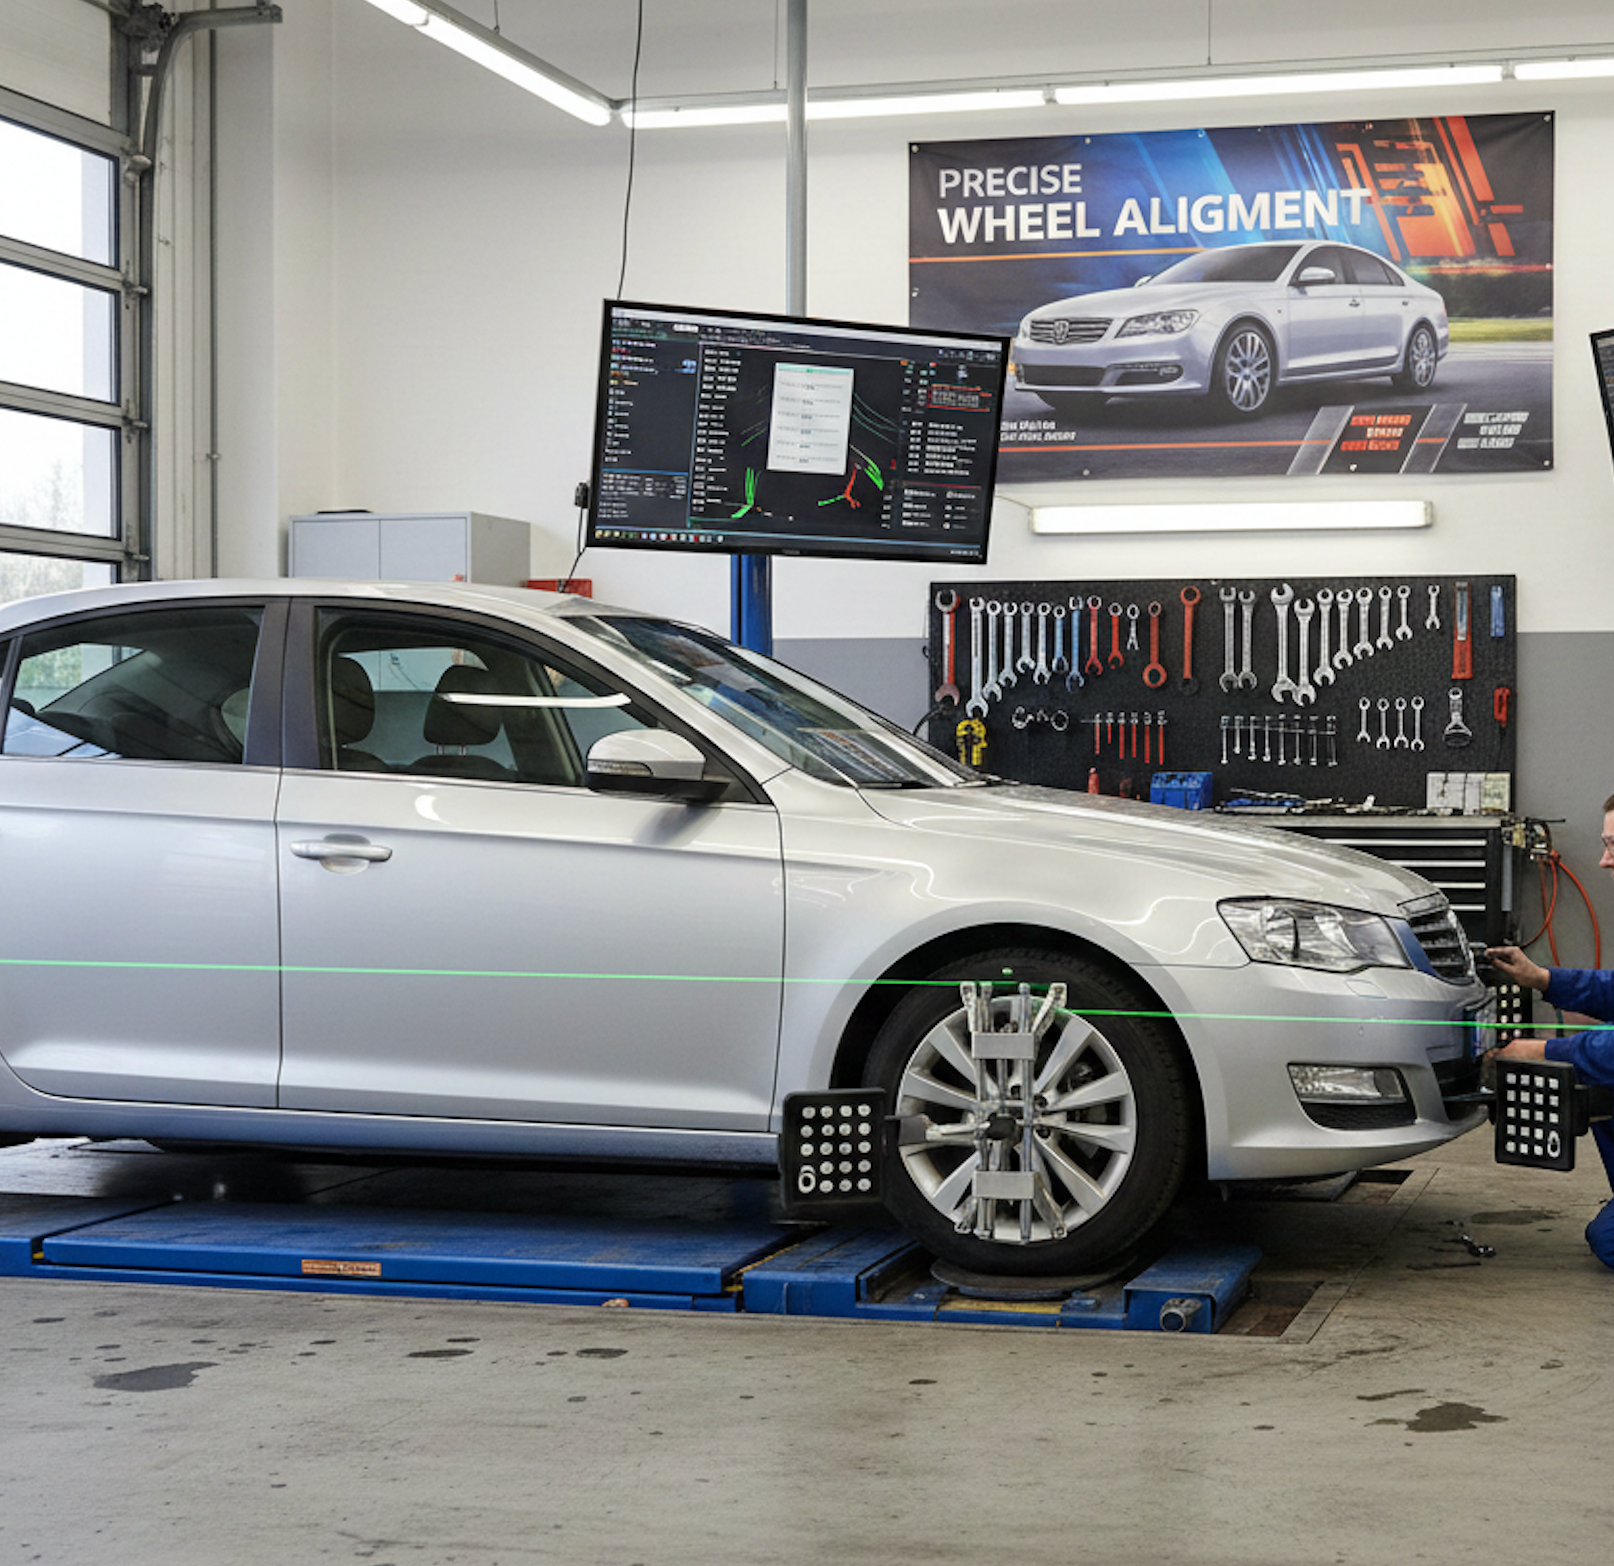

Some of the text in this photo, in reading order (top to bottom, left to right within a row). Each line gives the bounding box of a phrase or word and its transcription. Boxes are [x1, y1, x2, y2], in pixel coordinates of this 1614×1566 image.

[939, 163, 1082, 199] PRECISE
[937, 187, 1372, 244] WHEEL ALIGMENT
